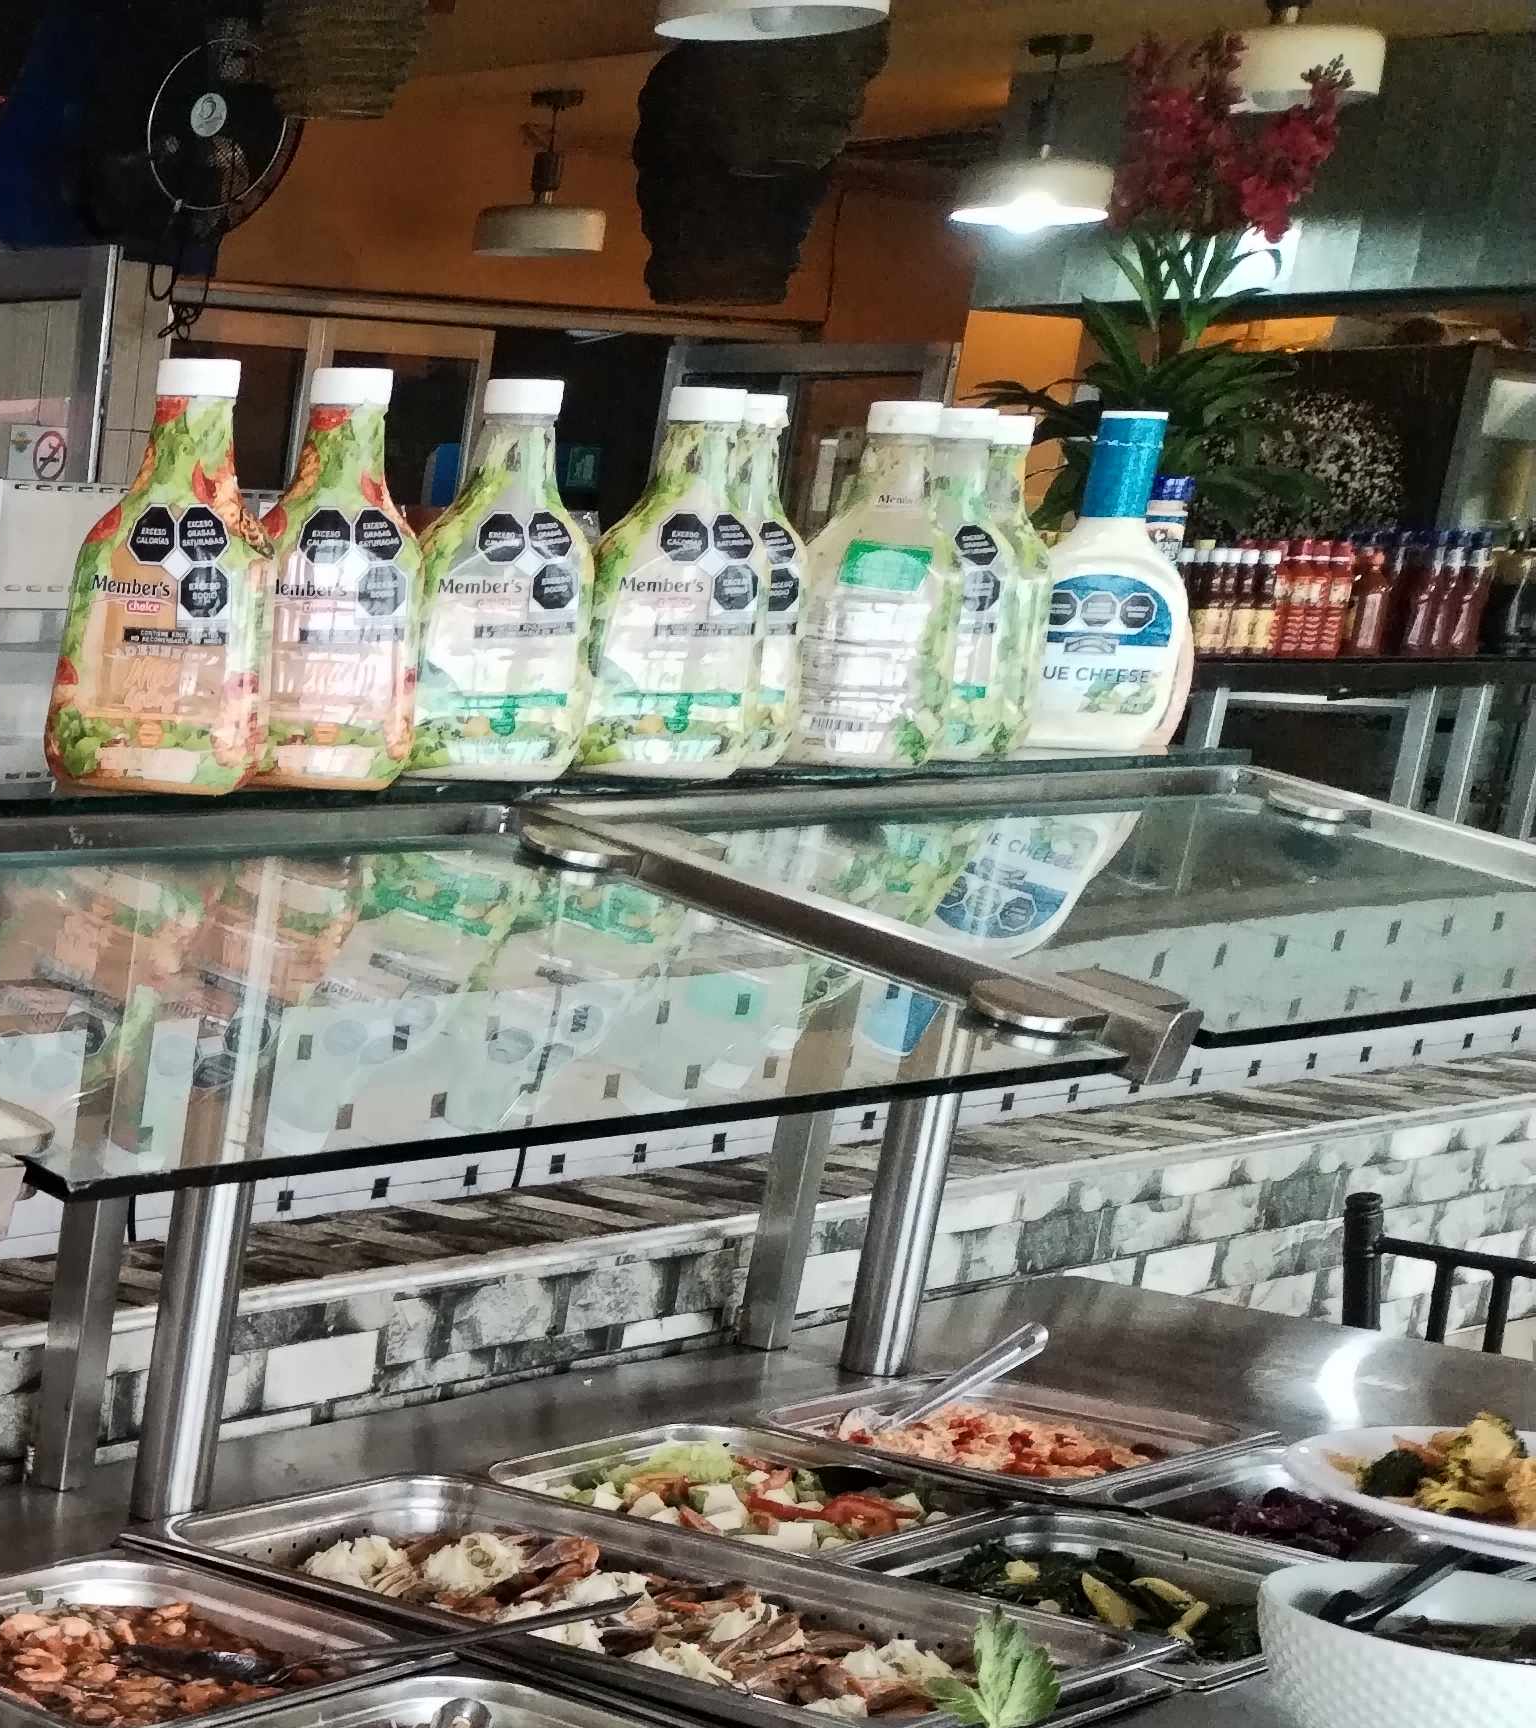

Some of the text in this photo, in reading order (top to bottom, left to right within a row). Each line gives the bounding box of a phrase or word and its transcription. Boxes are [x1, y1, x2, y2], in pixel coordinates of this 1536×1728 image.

[187, 520, 214, 528] EXCESO
[140, 527, 167, 536] EXCESO
[182, 537, 225, 547] SATURADAS
[92, 574, 171, 597] Member's
[438, 578, 523, 595] Member's
[618, 576, 704, 593] Member's
[128, 601, 160, 613] choice
[1042, 665, 1151, 684] UE CHEESE
